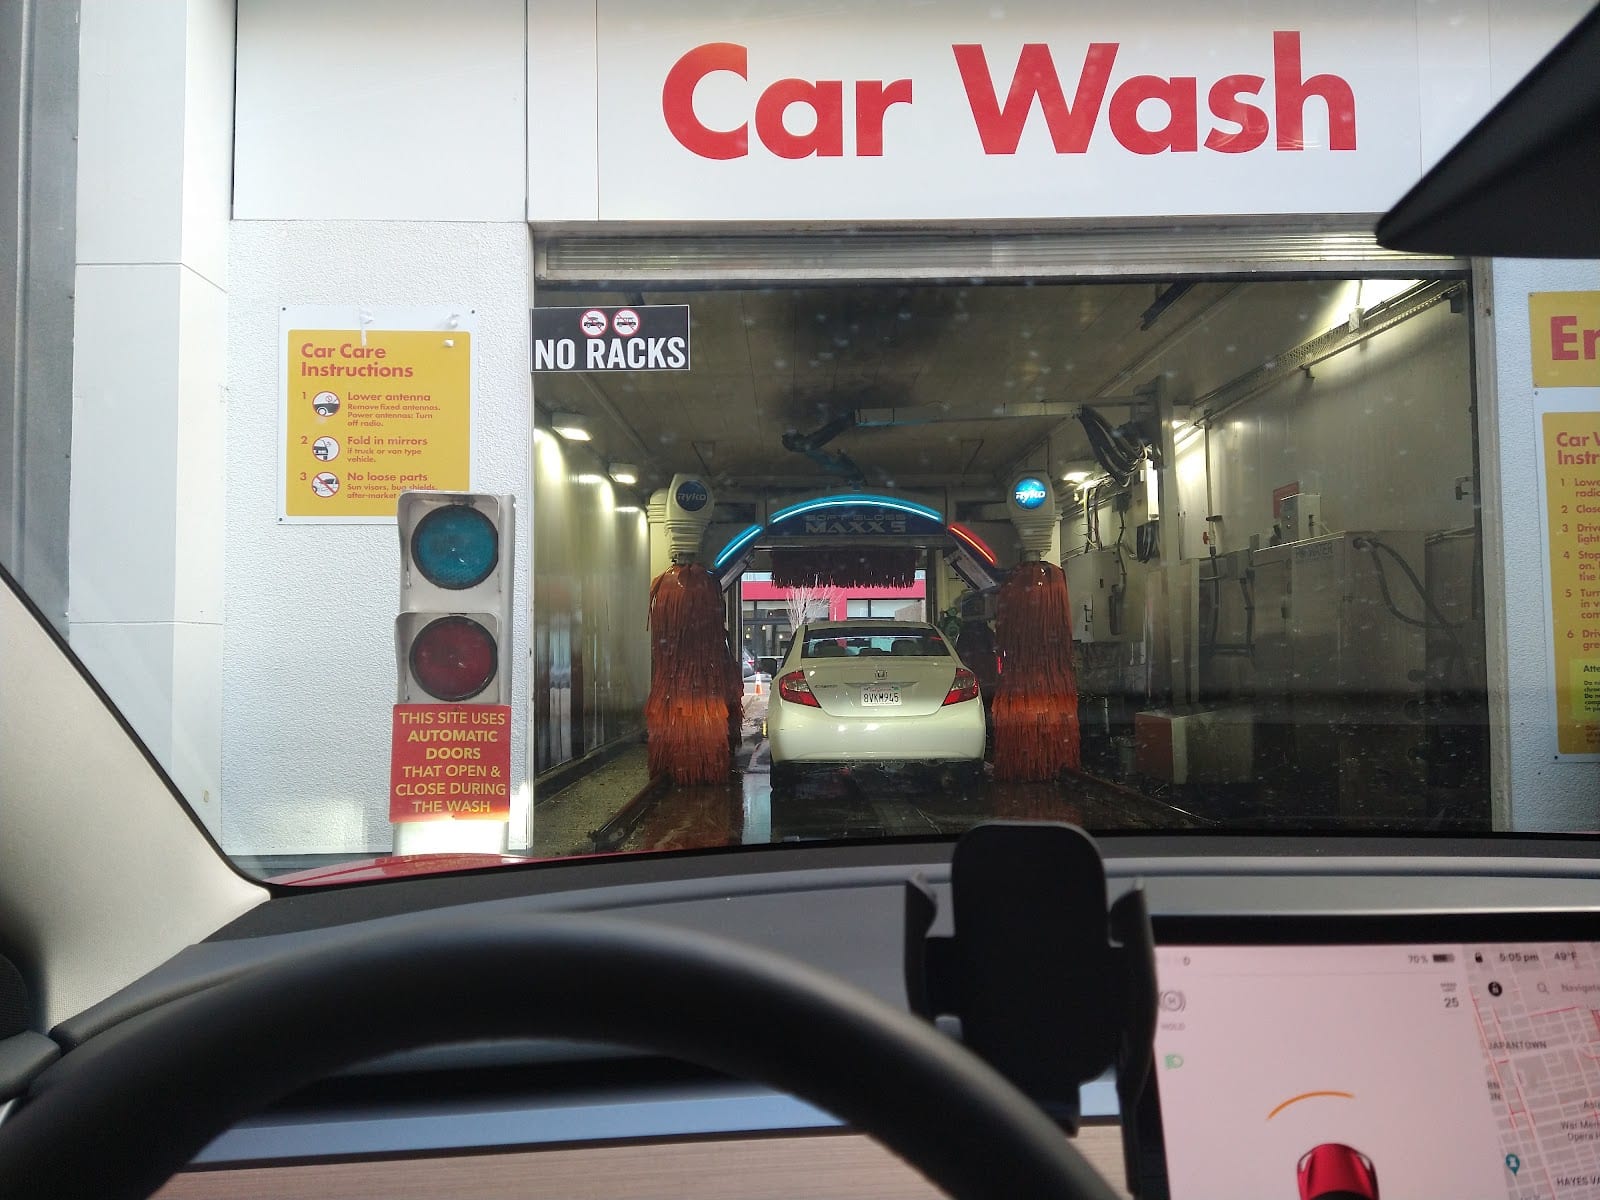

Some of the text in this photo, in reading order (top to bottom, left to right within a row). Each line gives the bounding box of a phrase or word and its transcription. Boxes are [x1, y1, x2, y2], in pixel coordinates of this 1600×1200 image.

[662, 31, 1357, 160] Car Wash
[301, 343, 386, 358] Car Care
[535, 337, 686, 370] NO RACKS
[301, 362, 413, 377] Instructions
[302, 391, 431, 401] 1 Lower antenna
[347, 403, 379, 411] Remove
[380, 403, 400, 411] fixed
[301, 436, 428, 446] 2 Fold in mirrors
[1556, 432, 1589, 447] Car
[347, 447, 353, 455] if
[354, 447, 374, 455] truck
[404, 448, 422, 456] type
[300, 472, 428, 483] 3 No loose parts
[1561, 505, 1568, 514] 2
[805, 521, 885, 533] MAXX
[1562, 524, 1569, 532] 3
[1563, 551, 1570, 559] 4
[1565, 589, 1572, 598] 5
[1580, 599, 1590, 608] in
[1567, 630, 1574, 638] 6
[399, 711, 505, 725] THIS SITE USES
[407, 730, 498, 742] AUTOMATIC
[425, 747, 481, 759] DOORS
[402, 764, 501, 778] THAT OPEN &
[395, 782, 506, 796] CLOSE DURING
[412, 800, 491, 813] THE WASH
[1489, 1040, 1547, 1050] JAPANTOWN
